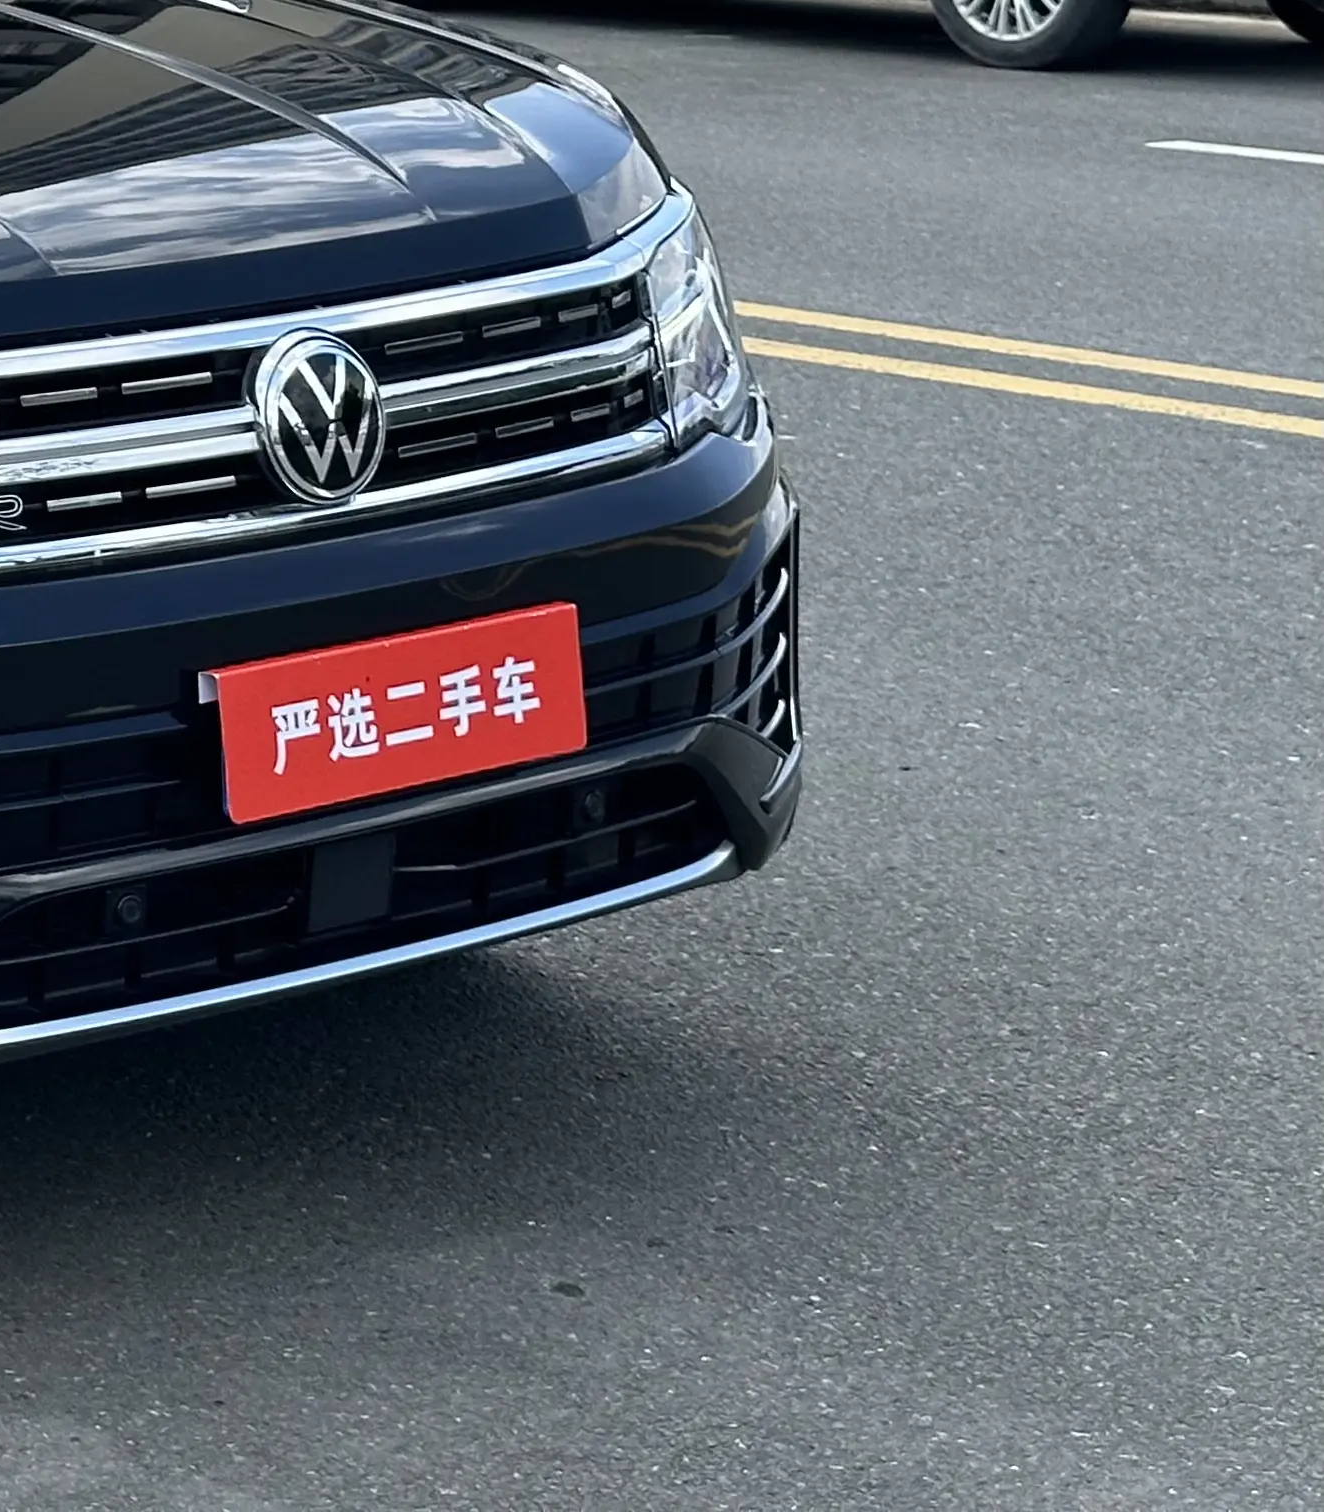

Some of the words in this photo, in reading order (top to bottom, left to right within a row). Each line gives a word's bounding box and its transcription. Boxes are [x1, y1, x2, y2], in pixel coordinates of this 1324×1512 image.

[270, 655, 542, 776] 严选二手车
